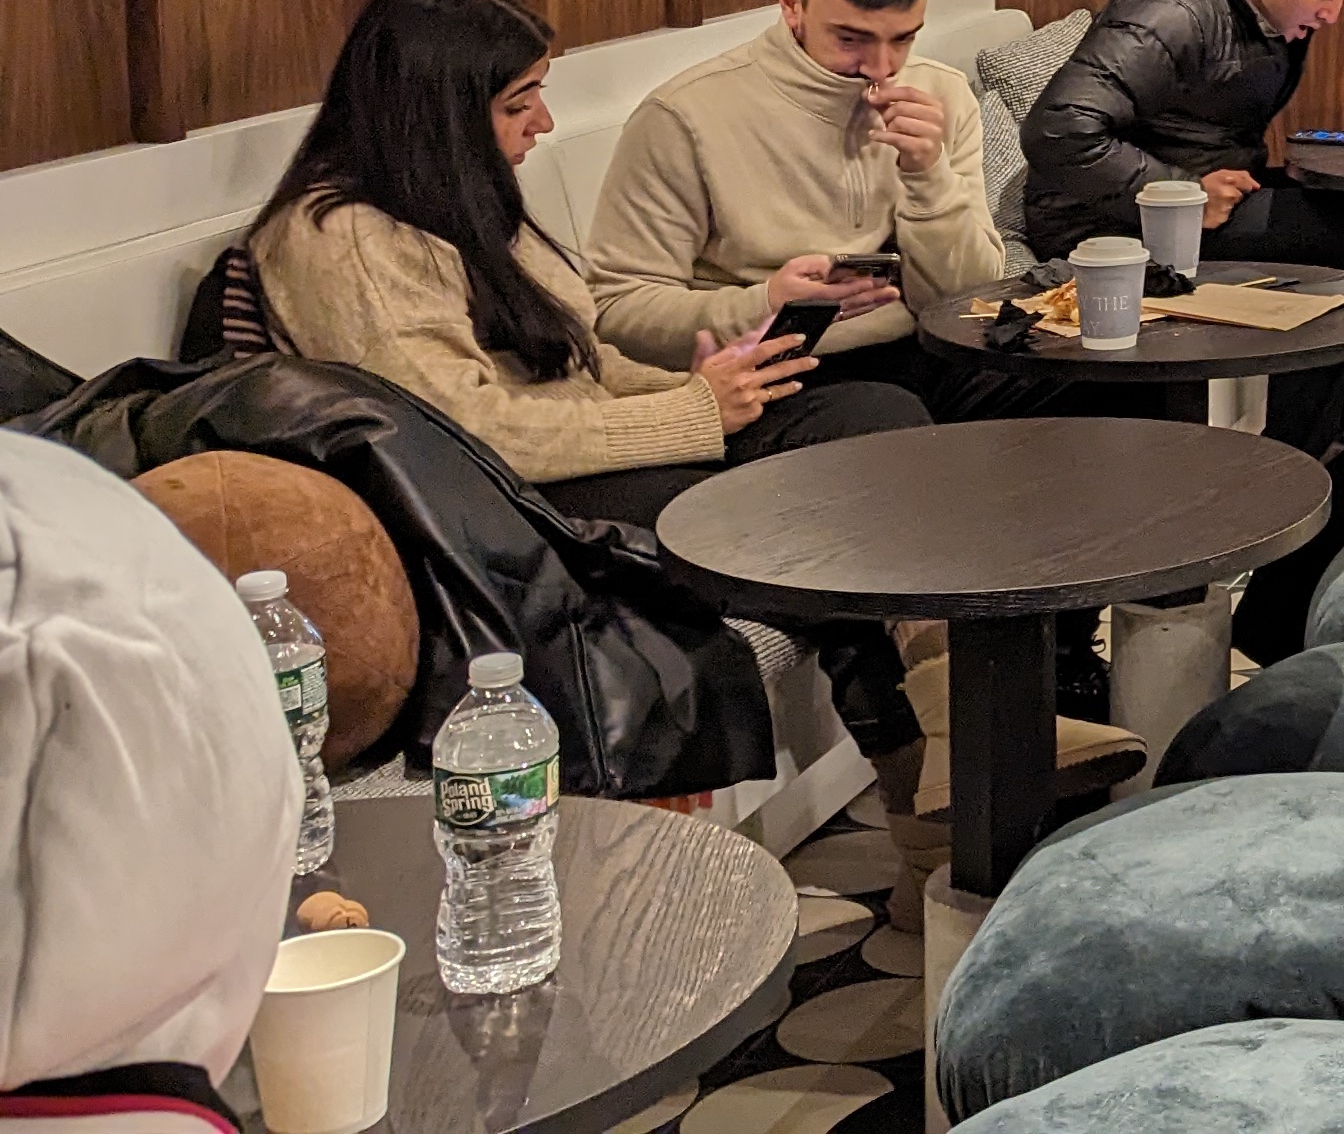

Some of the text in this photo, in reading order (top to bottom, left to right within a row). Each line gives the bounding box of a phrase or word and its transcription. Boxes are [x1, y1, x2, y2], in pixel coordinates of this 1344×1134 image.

[1093, 295, 1129, 311] THE
[441, 777, 492, 799] Poland
[442, 795, 495, 817] Spring
